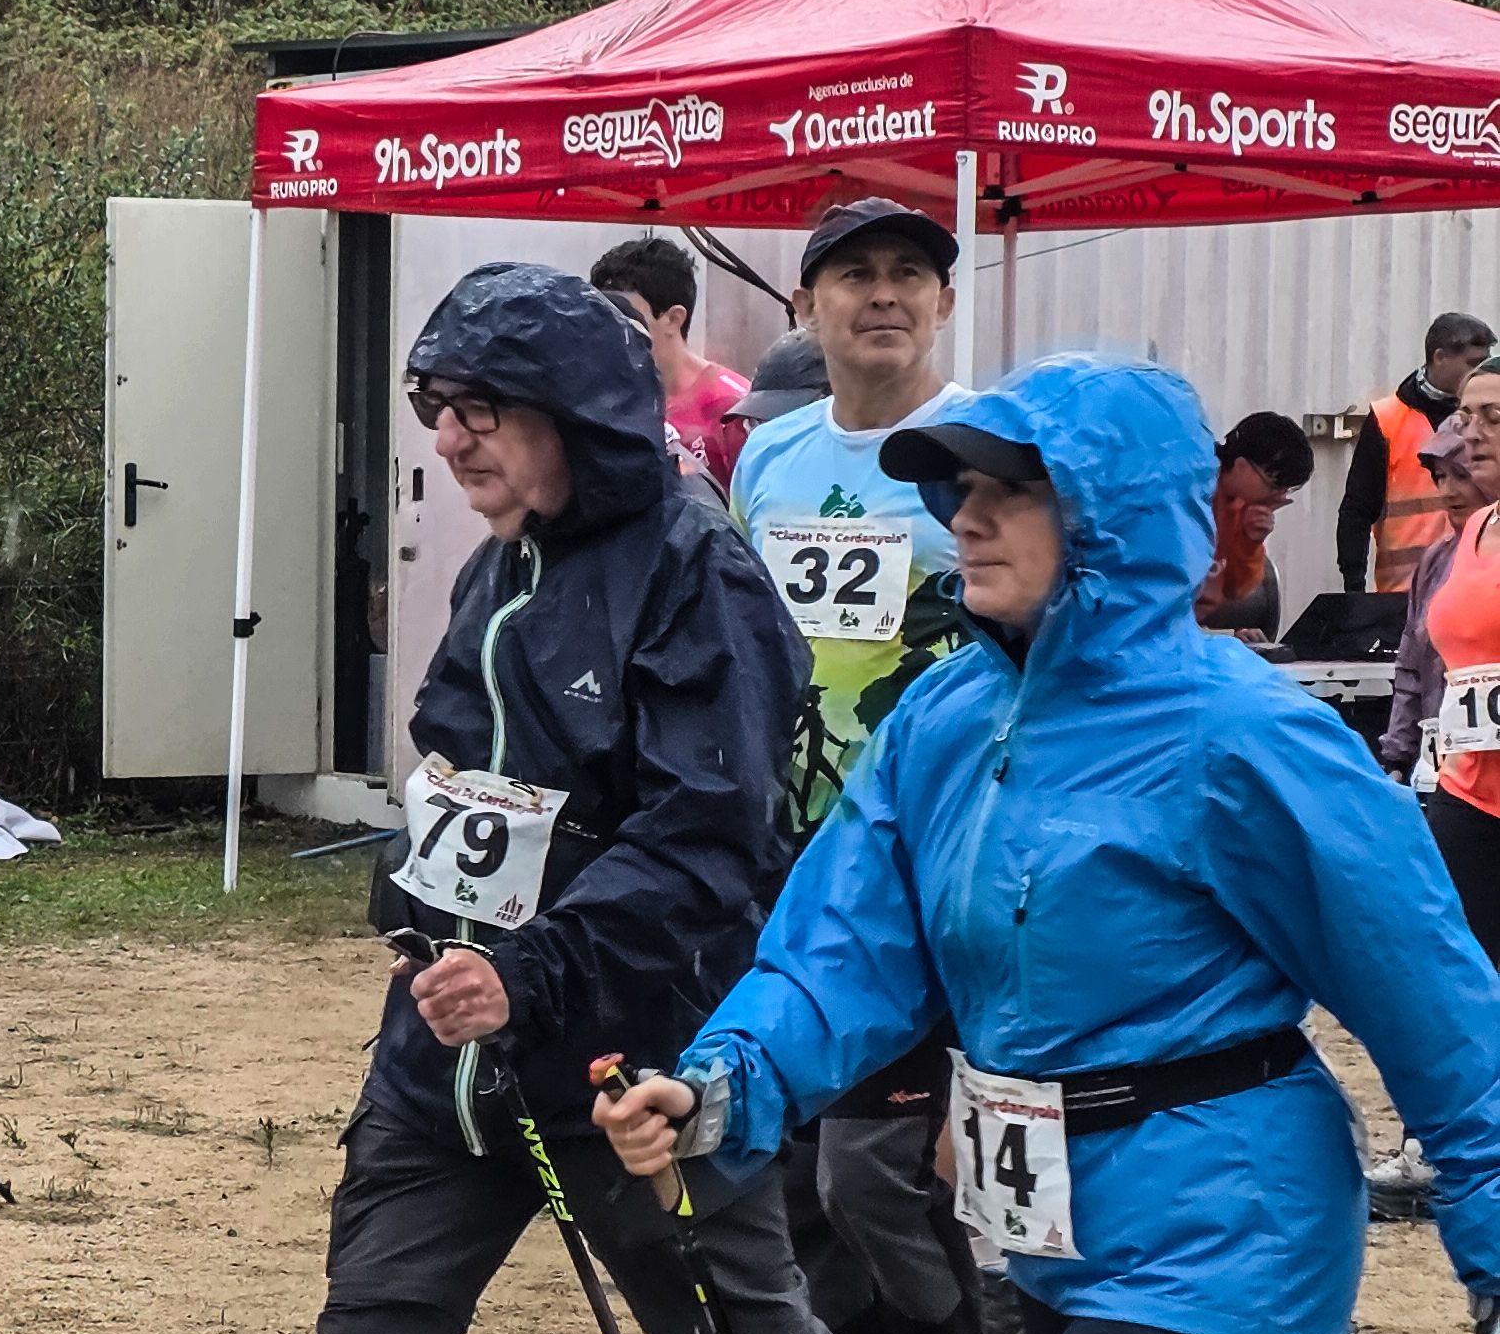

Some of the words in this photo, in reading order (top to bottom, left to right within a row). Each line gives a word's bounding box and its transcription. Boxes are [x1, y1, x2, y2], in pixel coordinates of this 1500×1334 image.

[808, 81, 849, 102] Agencia
[851, 75, 899, 95] exclusiva
[900, 71, 914, 88] de
[804, 100, 937, 150] Occident
[1147, 89, 1337, 156] 9h.Sports
[373, 129, 522, 190] 9h.Sports
[785, 546, 881, 606] 32
[418, 792, 510, 879] 79
[517, 1117, 574, 1223] FIZAN
[963, 1106, 1038, 1209] 14
